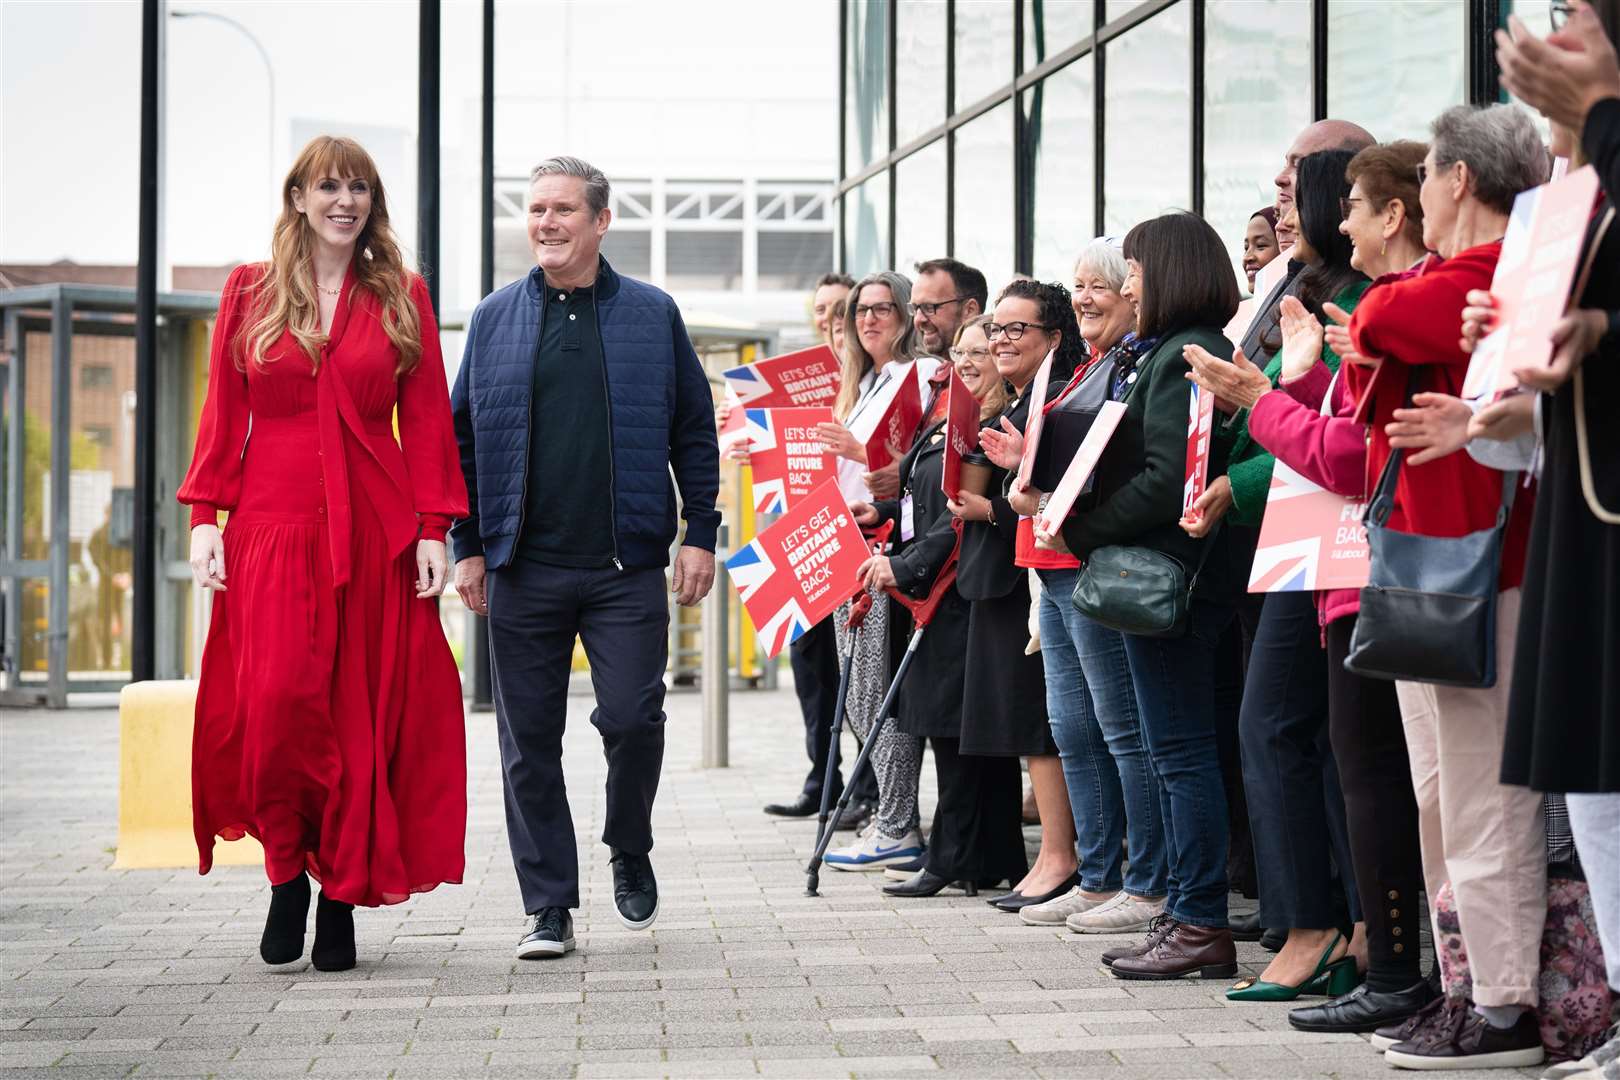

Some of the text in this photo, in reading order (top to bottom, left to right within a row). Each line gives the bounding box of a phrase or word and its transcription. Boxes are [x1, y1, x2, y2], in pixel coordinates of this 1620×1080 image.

[778, 362, 827, 383] LET'S GET
[790, 386, 836, 405] FUTURE
[784, 427, 820, 440] LET'S GE
[787, 457, 823, 470] FUTURE
[788, 472, 813, 485] BACK
[780, 506, 831, 552] LET'S GET
[1335, 526, 1369, 545] BAC
[787, 513, 848, 567] BRITAIN'S
[793, 537, 842, 581] FUTURE
[800, 563, 833, 594] BACK
